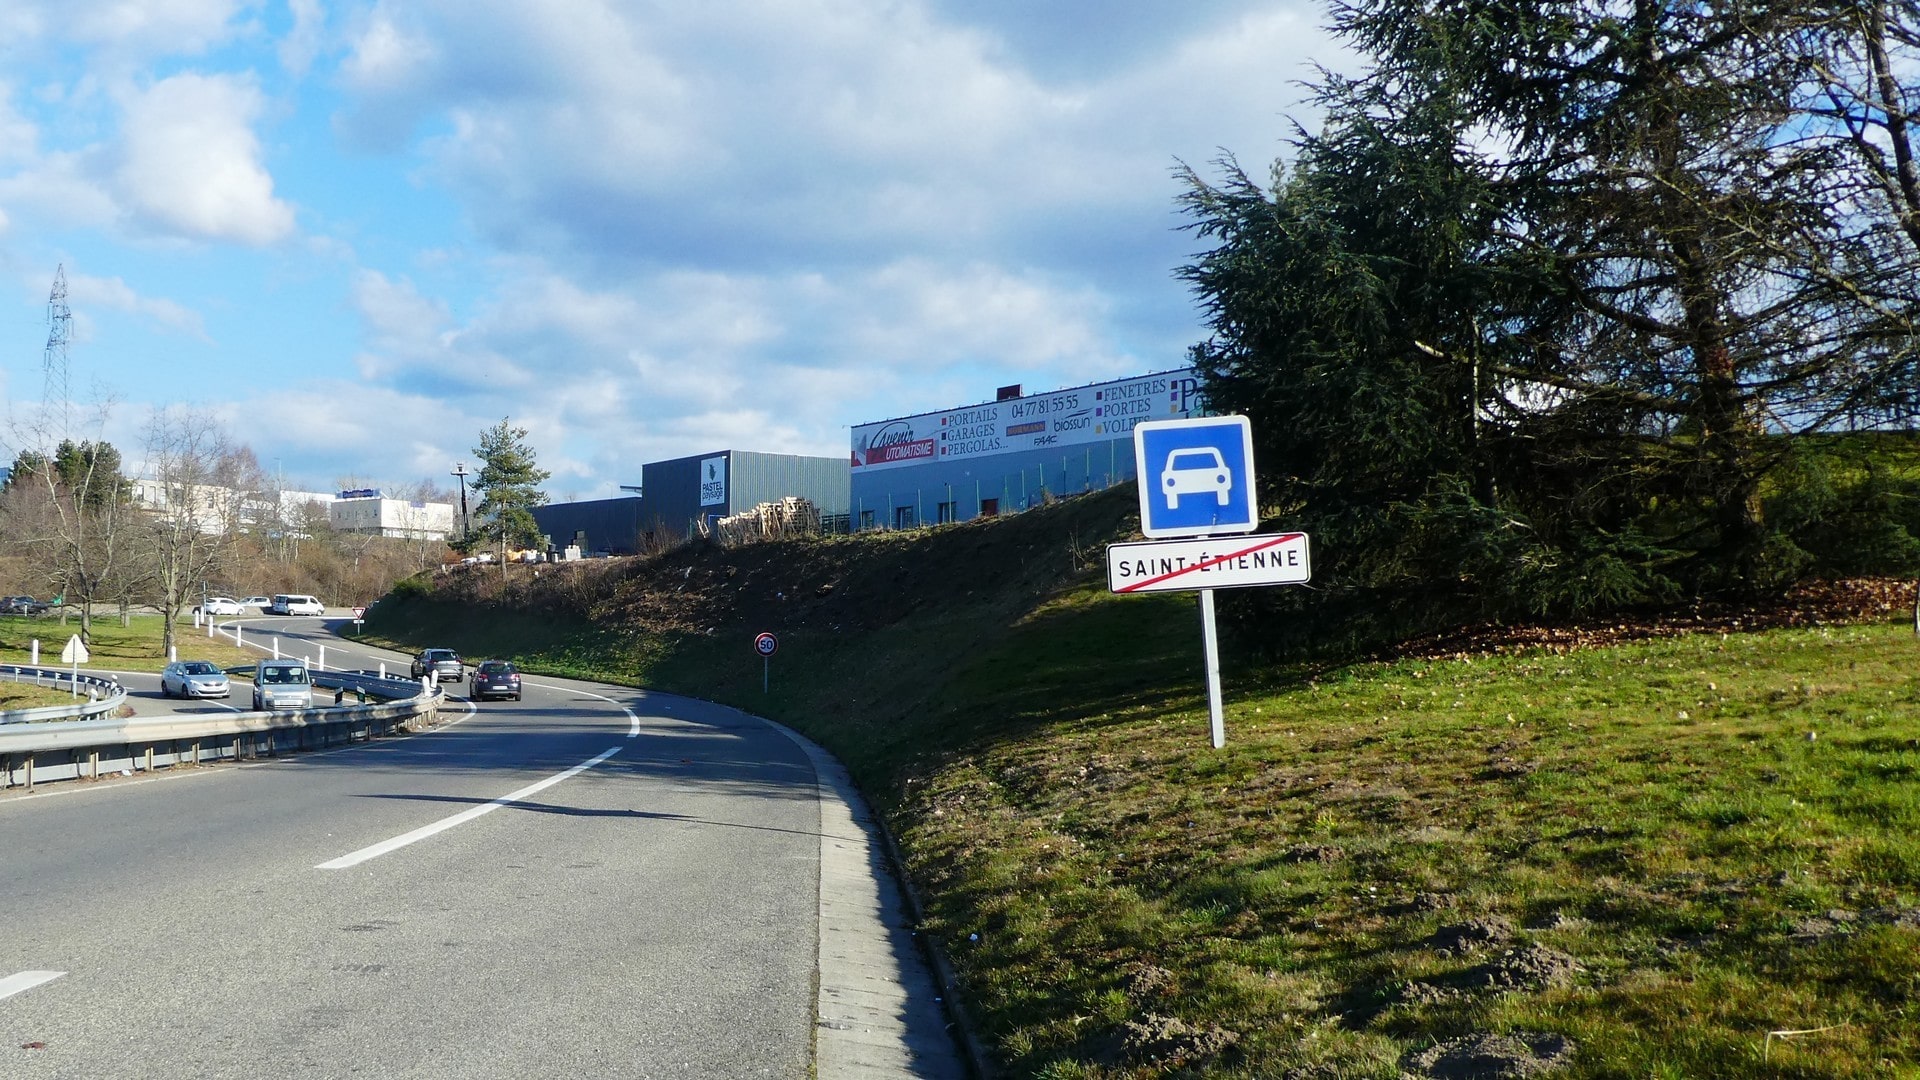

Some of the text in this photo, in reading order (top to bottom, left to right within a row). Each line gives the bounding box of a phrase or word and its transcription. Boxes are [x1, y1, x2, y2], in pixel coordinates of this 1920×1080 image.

[1104, 379, 1166, 401] FENETRES
[1011, 394, 1079, 419] 04 77 81 55 55
[1103, 398, 1151, 418] PORTES
[949, 408, 998, 426] PORTAILS
[1053, 417, 1091, 432] biossun
[947, 423, 995, 441] GARAGES
[702, 481, 723, 491] PASTEL
[1119, 550, 1299, 577] SAINT-ÉTIENNE
[760, 640, 774, 650] 50
